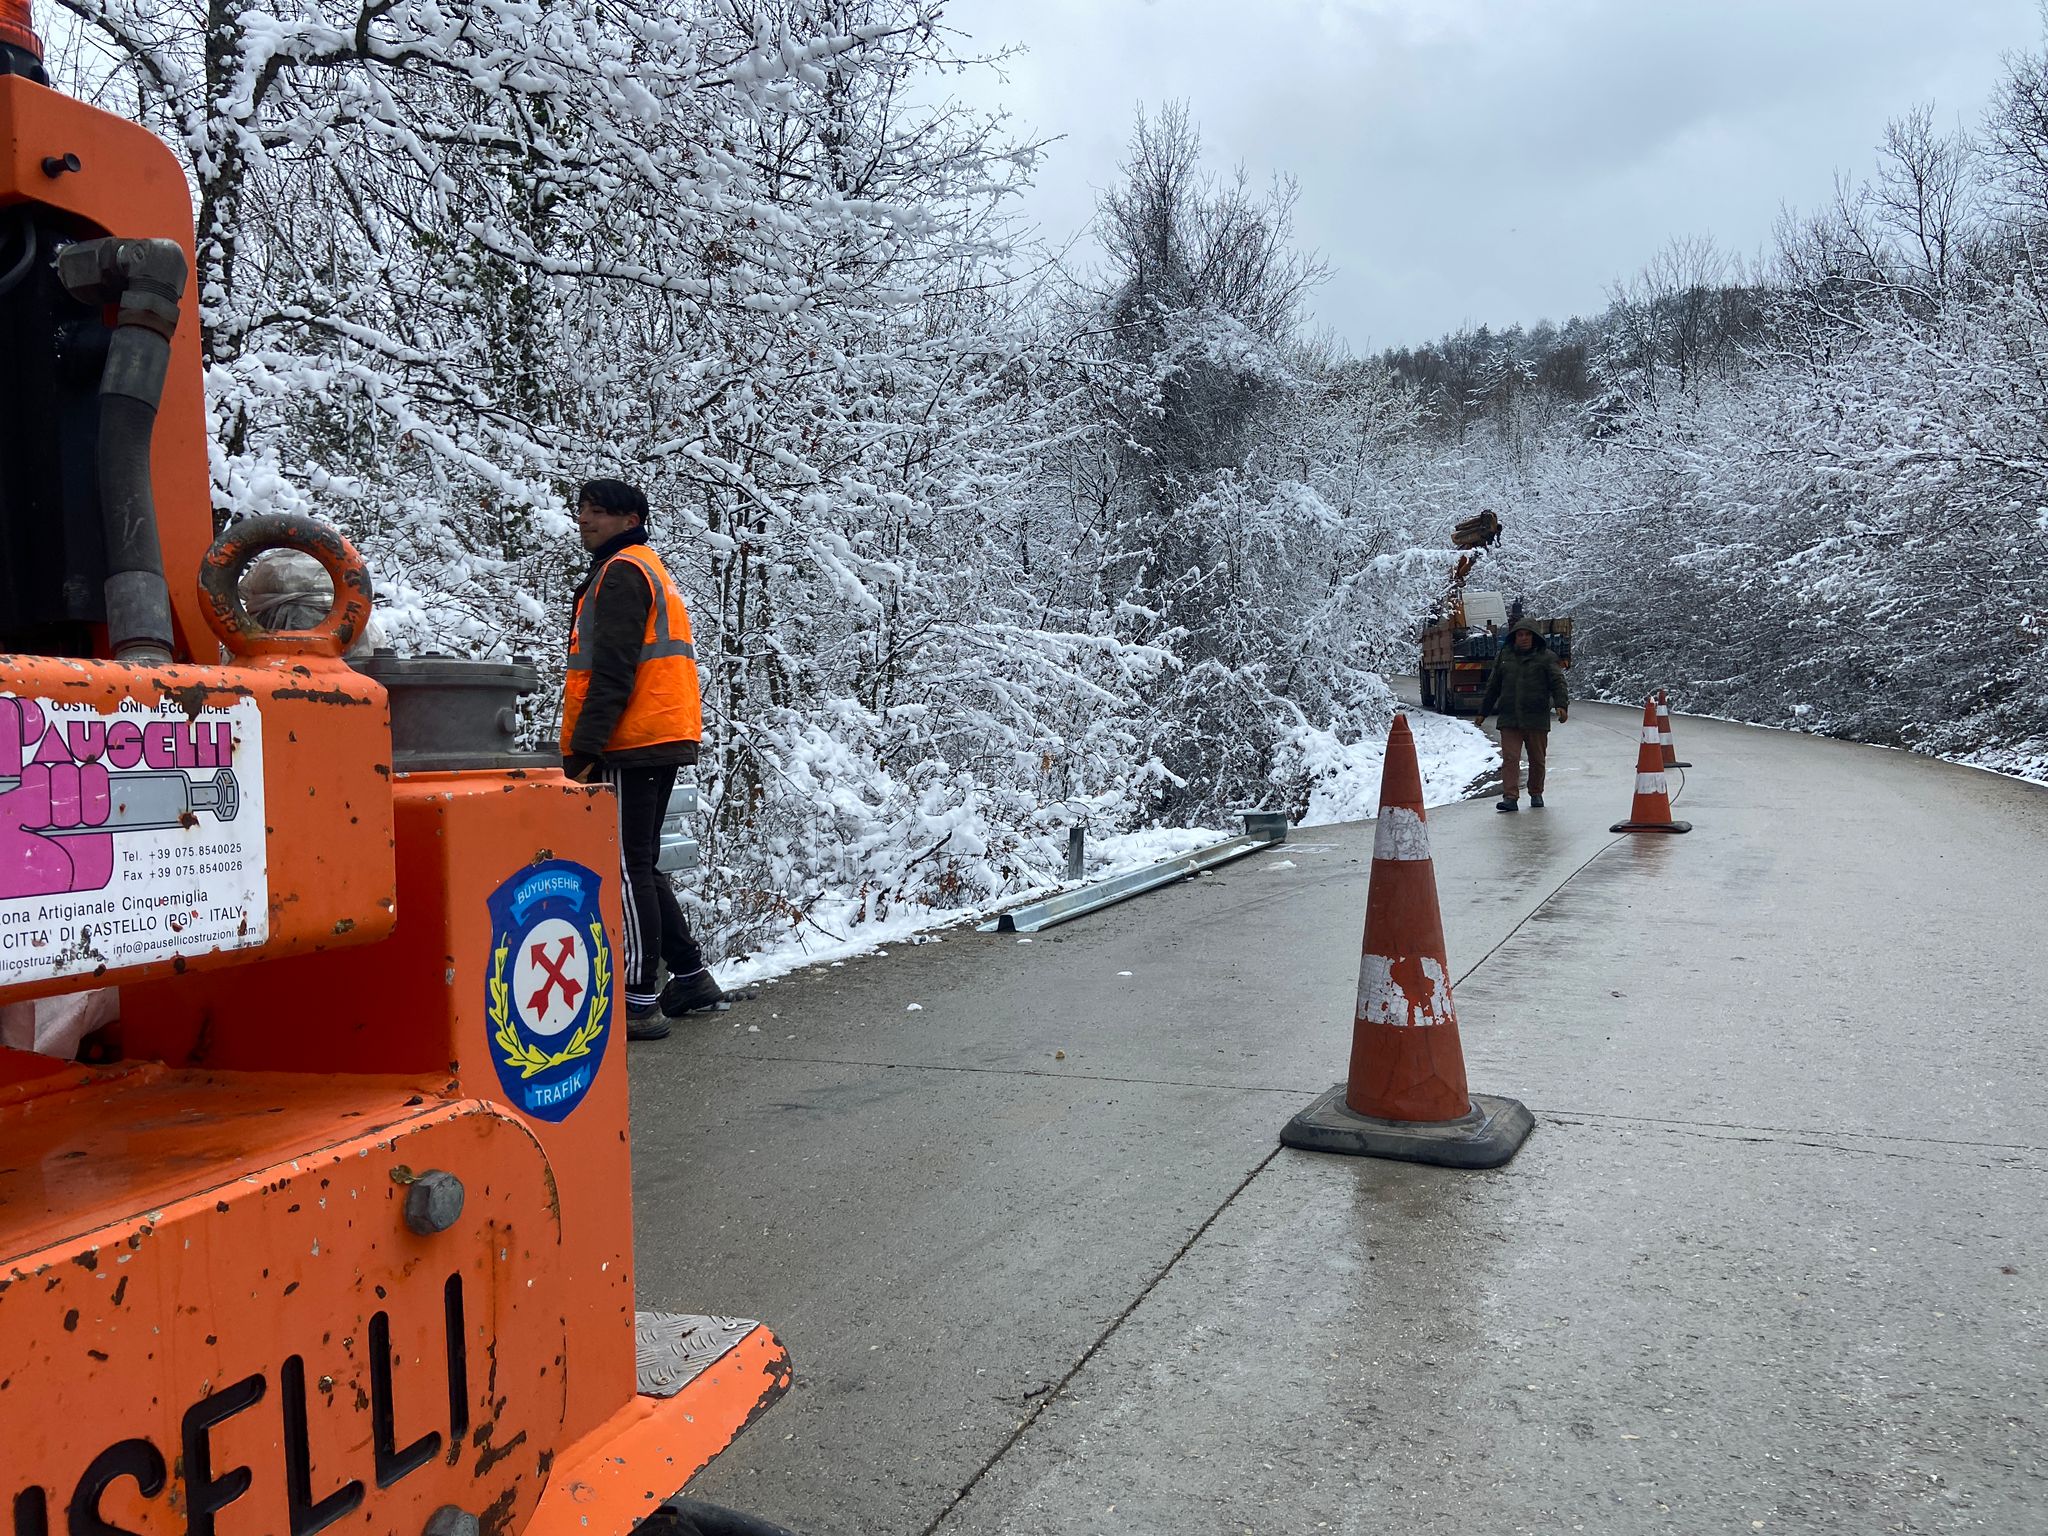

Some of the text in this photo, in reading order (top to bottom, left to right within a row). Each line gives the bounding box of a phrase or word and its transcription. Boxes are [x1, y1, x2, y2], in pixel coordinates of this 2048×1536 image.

[51, 700, 230, 714] COSTRONI MECCICHE
[122, 843, 242, 862] Tel. +39 075.8540025
[123, 861, 243, 881] Fax +39 075.8540026
[0, 889, 208, 926] ona Artigianale Cinquemiglia
[60, 926, 75, 942] DI
[82, 916, 157, 938] CASTELLO
[165, 911, 193, 931] (PG)
[210, 905, 243, 922] ITALY
[0, 946, 98, 971] licostruzionico
[113, 927, 256, 954] info@pausellicostruzioni.om
[535, 1073, 582, 1106] TRAFİK
